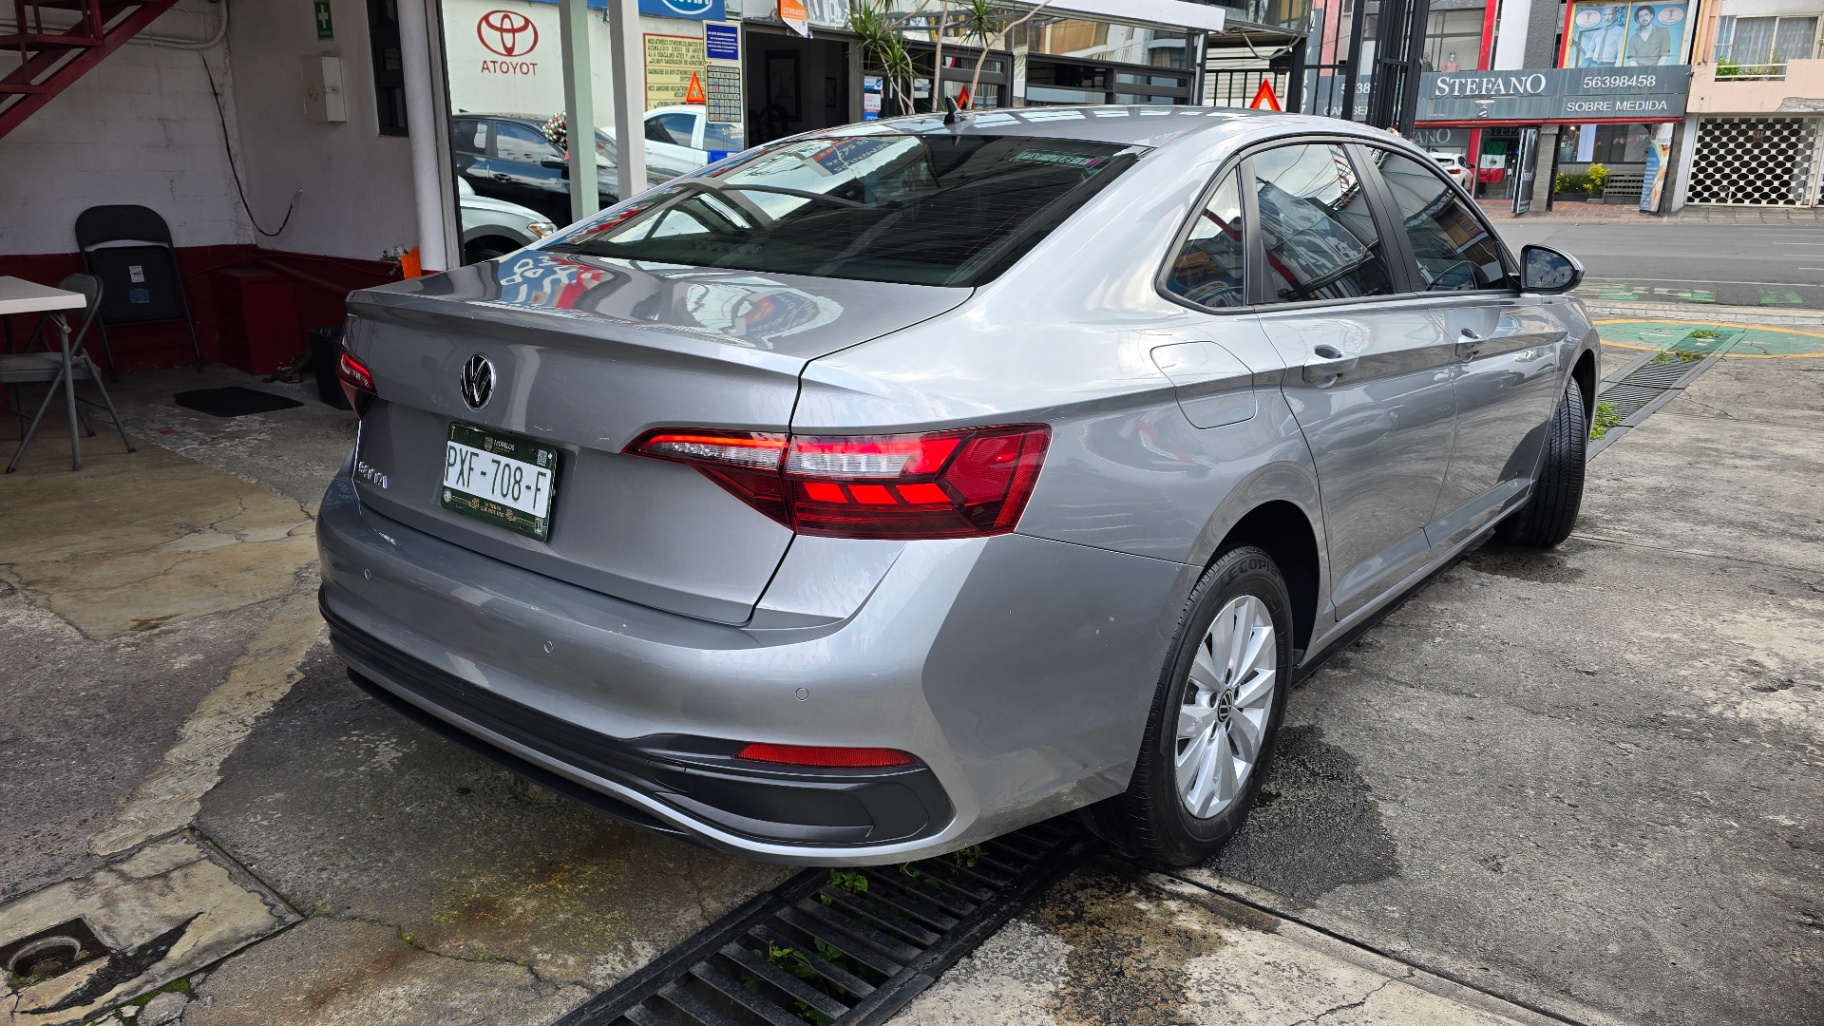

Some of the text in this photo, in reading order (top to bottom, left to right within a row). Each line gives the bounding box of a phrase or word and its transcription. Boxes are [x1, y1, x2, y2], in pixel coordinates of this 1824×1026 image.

[1434, 73, 1547, 96] STEFANO
[1583, 75, 1656, 89] 56398458
[1566, 100, 1668, 111] SOBRE MEDIDA
[445, 445, 547, 510] PXF-708-F
